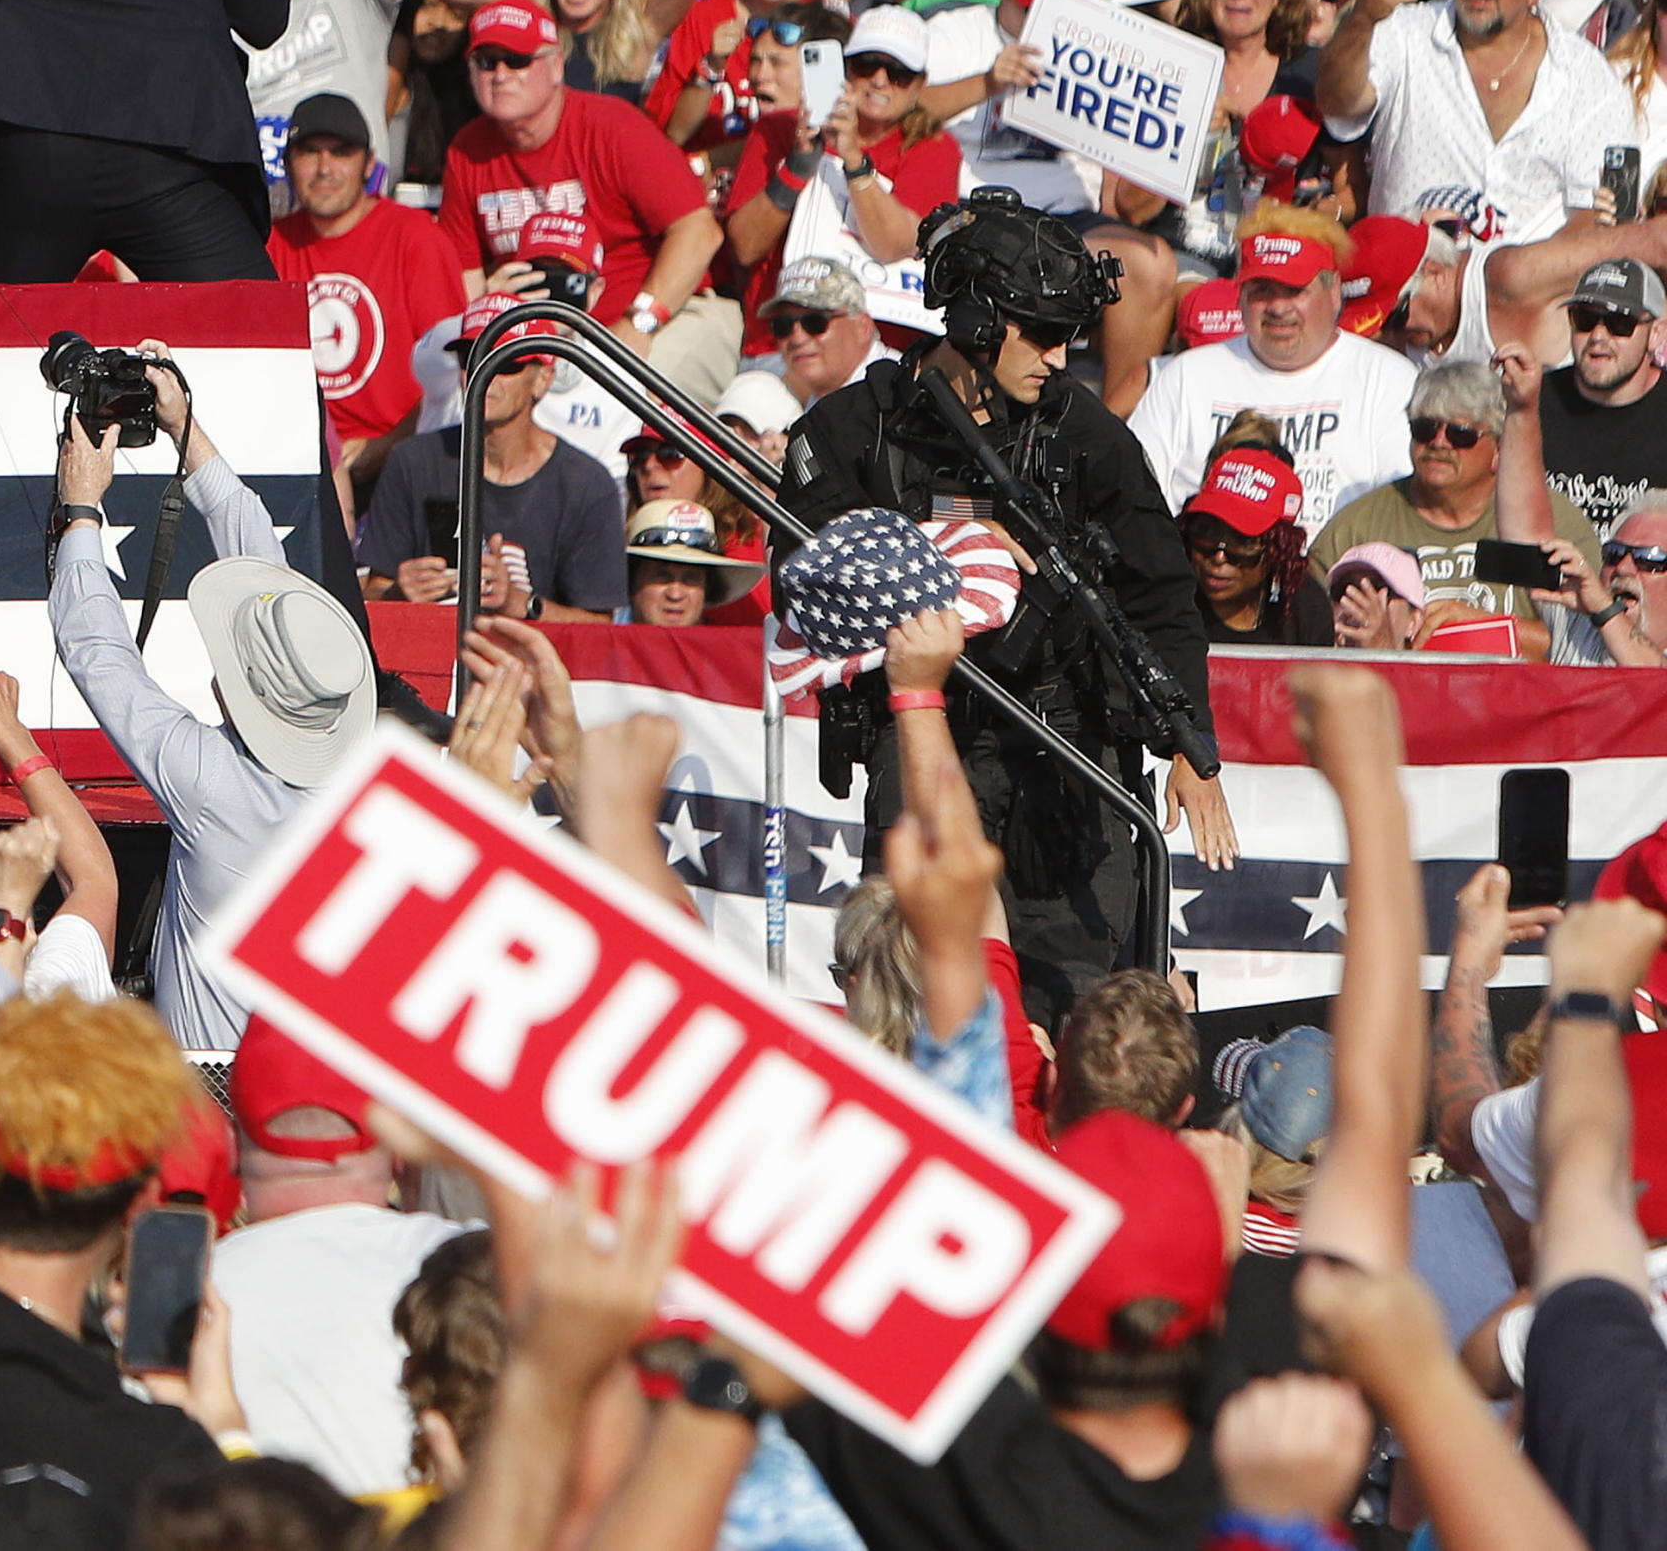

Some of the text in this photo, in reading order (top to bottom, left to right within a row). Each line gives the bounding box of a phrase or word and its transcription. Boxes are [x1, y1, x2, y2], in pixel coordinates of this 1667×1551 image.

[1051, 34, 1183, 115] YOU'RE
[1030, 68, 1188, 162] FIRED!
[532, 216, 587, 234] TRUMP
[1254, 236, 1303, 256] Trump
[568, 403, 602, 427] PA
[1211, 410, 1340, 456] TMP
[1215, 474, 1269, 502] TRUMP
[1221, 461, 1276, 488] MARYLAND
[295, 783, 1032, 1338] TRUMP
